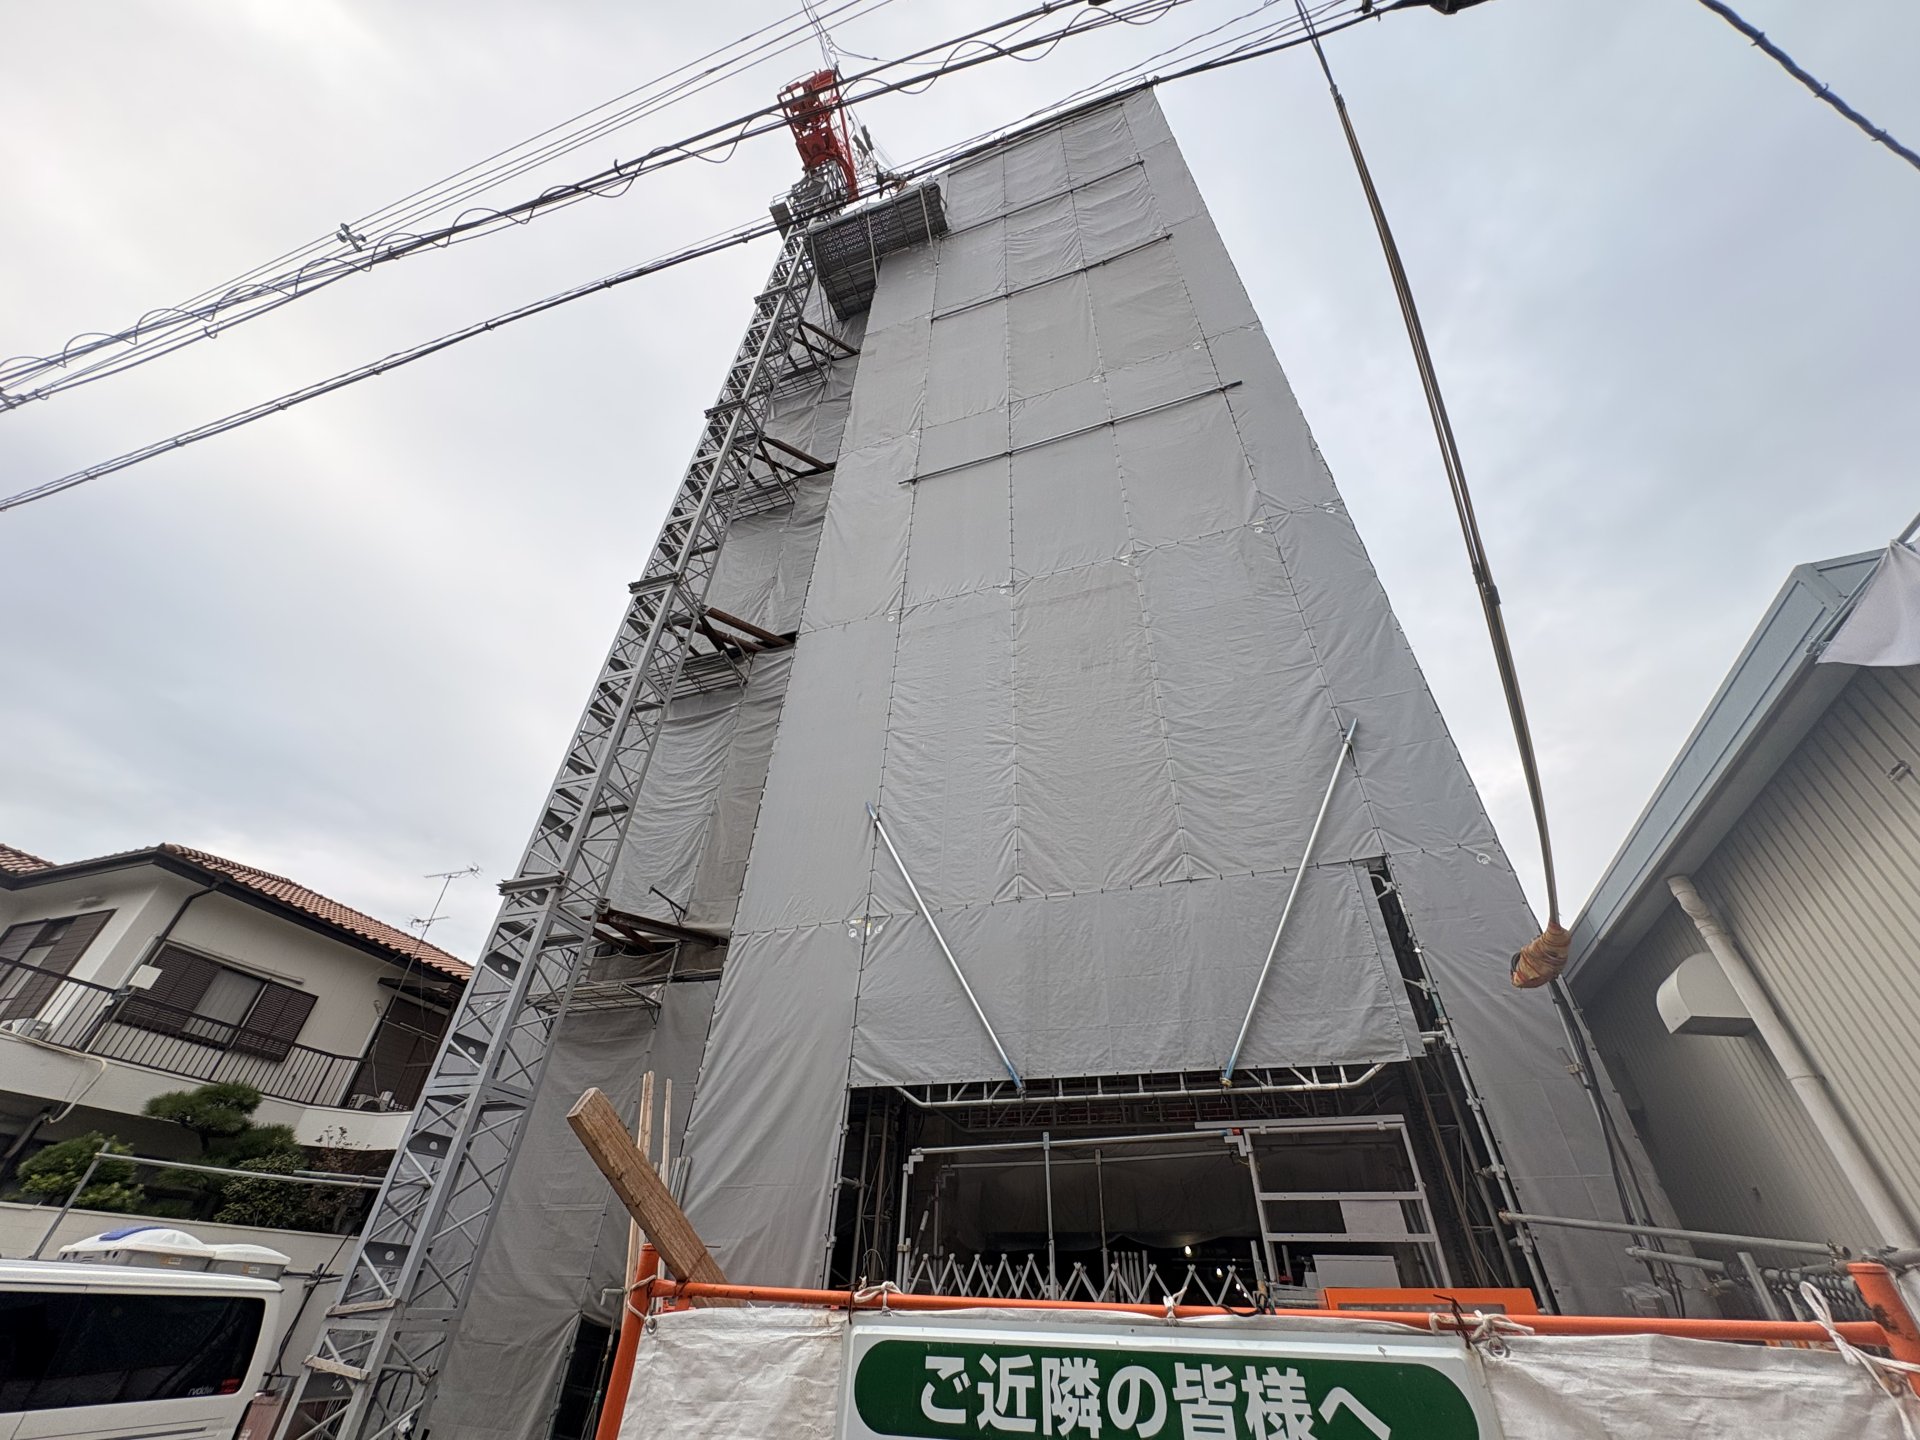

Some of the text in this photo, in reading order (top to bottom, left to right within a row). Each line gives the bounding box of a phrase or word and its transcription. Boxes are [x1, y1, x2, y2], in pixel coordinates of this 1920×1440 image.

[920, 1354, 1391, 1440] ご近隣の皆様へ
